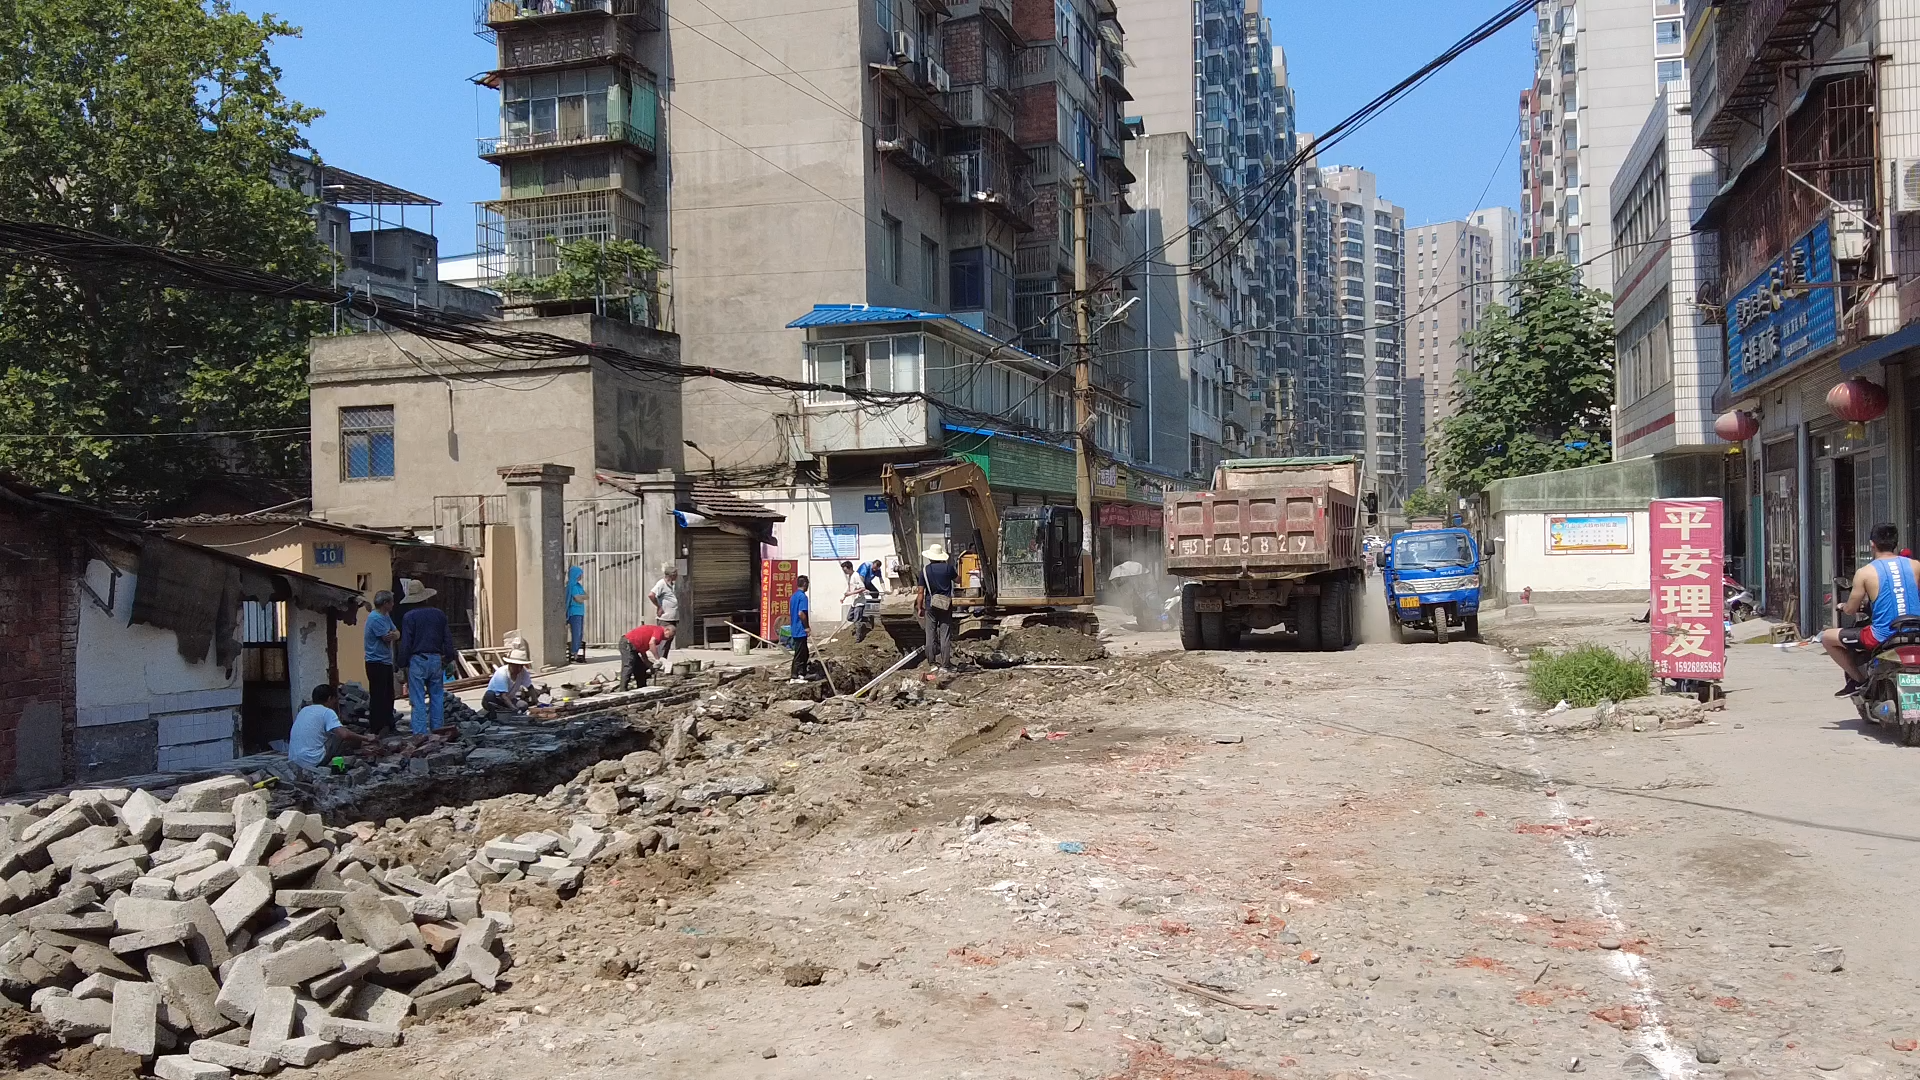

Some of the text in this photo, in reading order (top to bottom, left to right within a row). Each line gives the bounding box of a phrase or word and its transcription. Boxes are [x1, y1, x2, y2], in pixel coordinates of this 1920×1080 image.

[321, 550, 336, 562] 10
[1659, 506, 1714, 658] 平安理发
